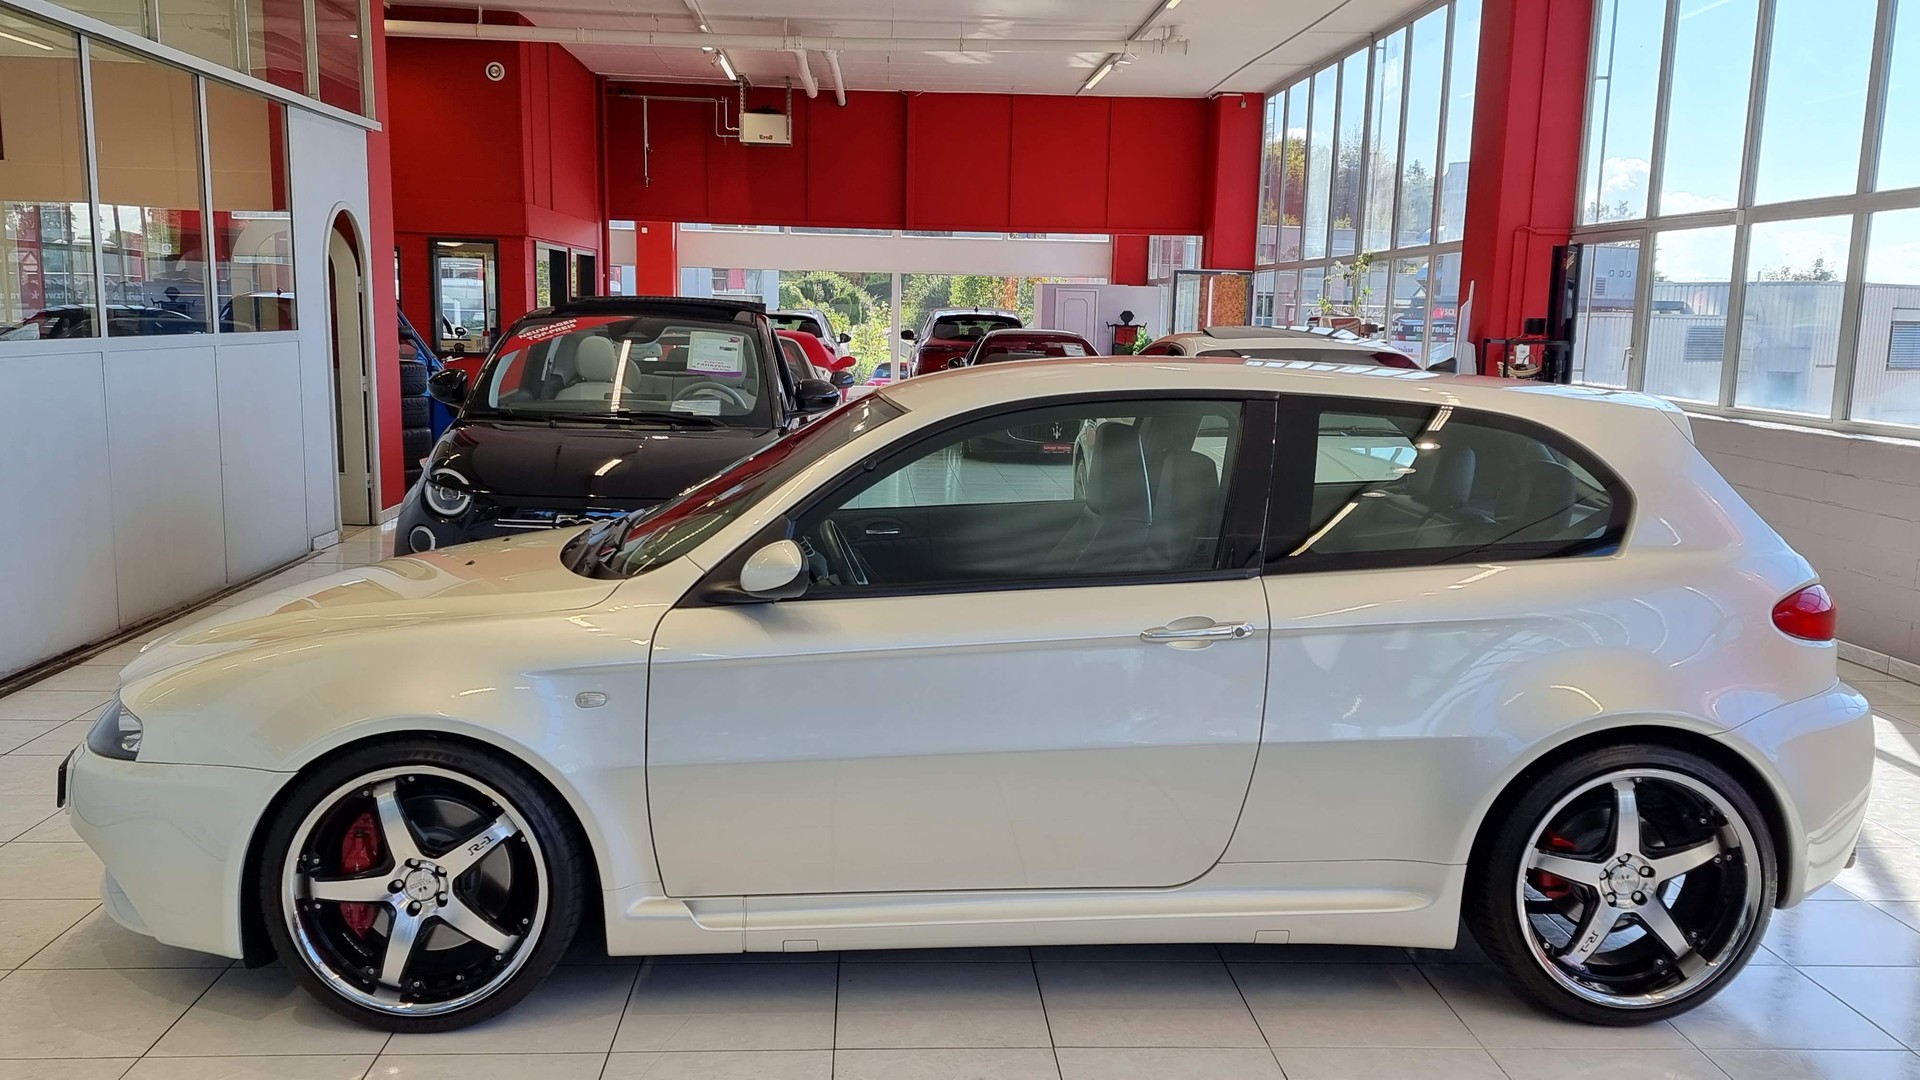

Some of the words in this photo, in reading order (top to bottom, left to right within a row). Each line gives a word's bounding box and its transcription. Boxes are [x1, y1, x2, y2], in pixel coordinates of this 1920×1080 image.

[518, 318, 577, 339] NEUWAGEN
[527, 323, 576, 340] TOP-PREIS
[467, 835, 495, 856] R-1
[1578, 930, 1600, 953] R-1
